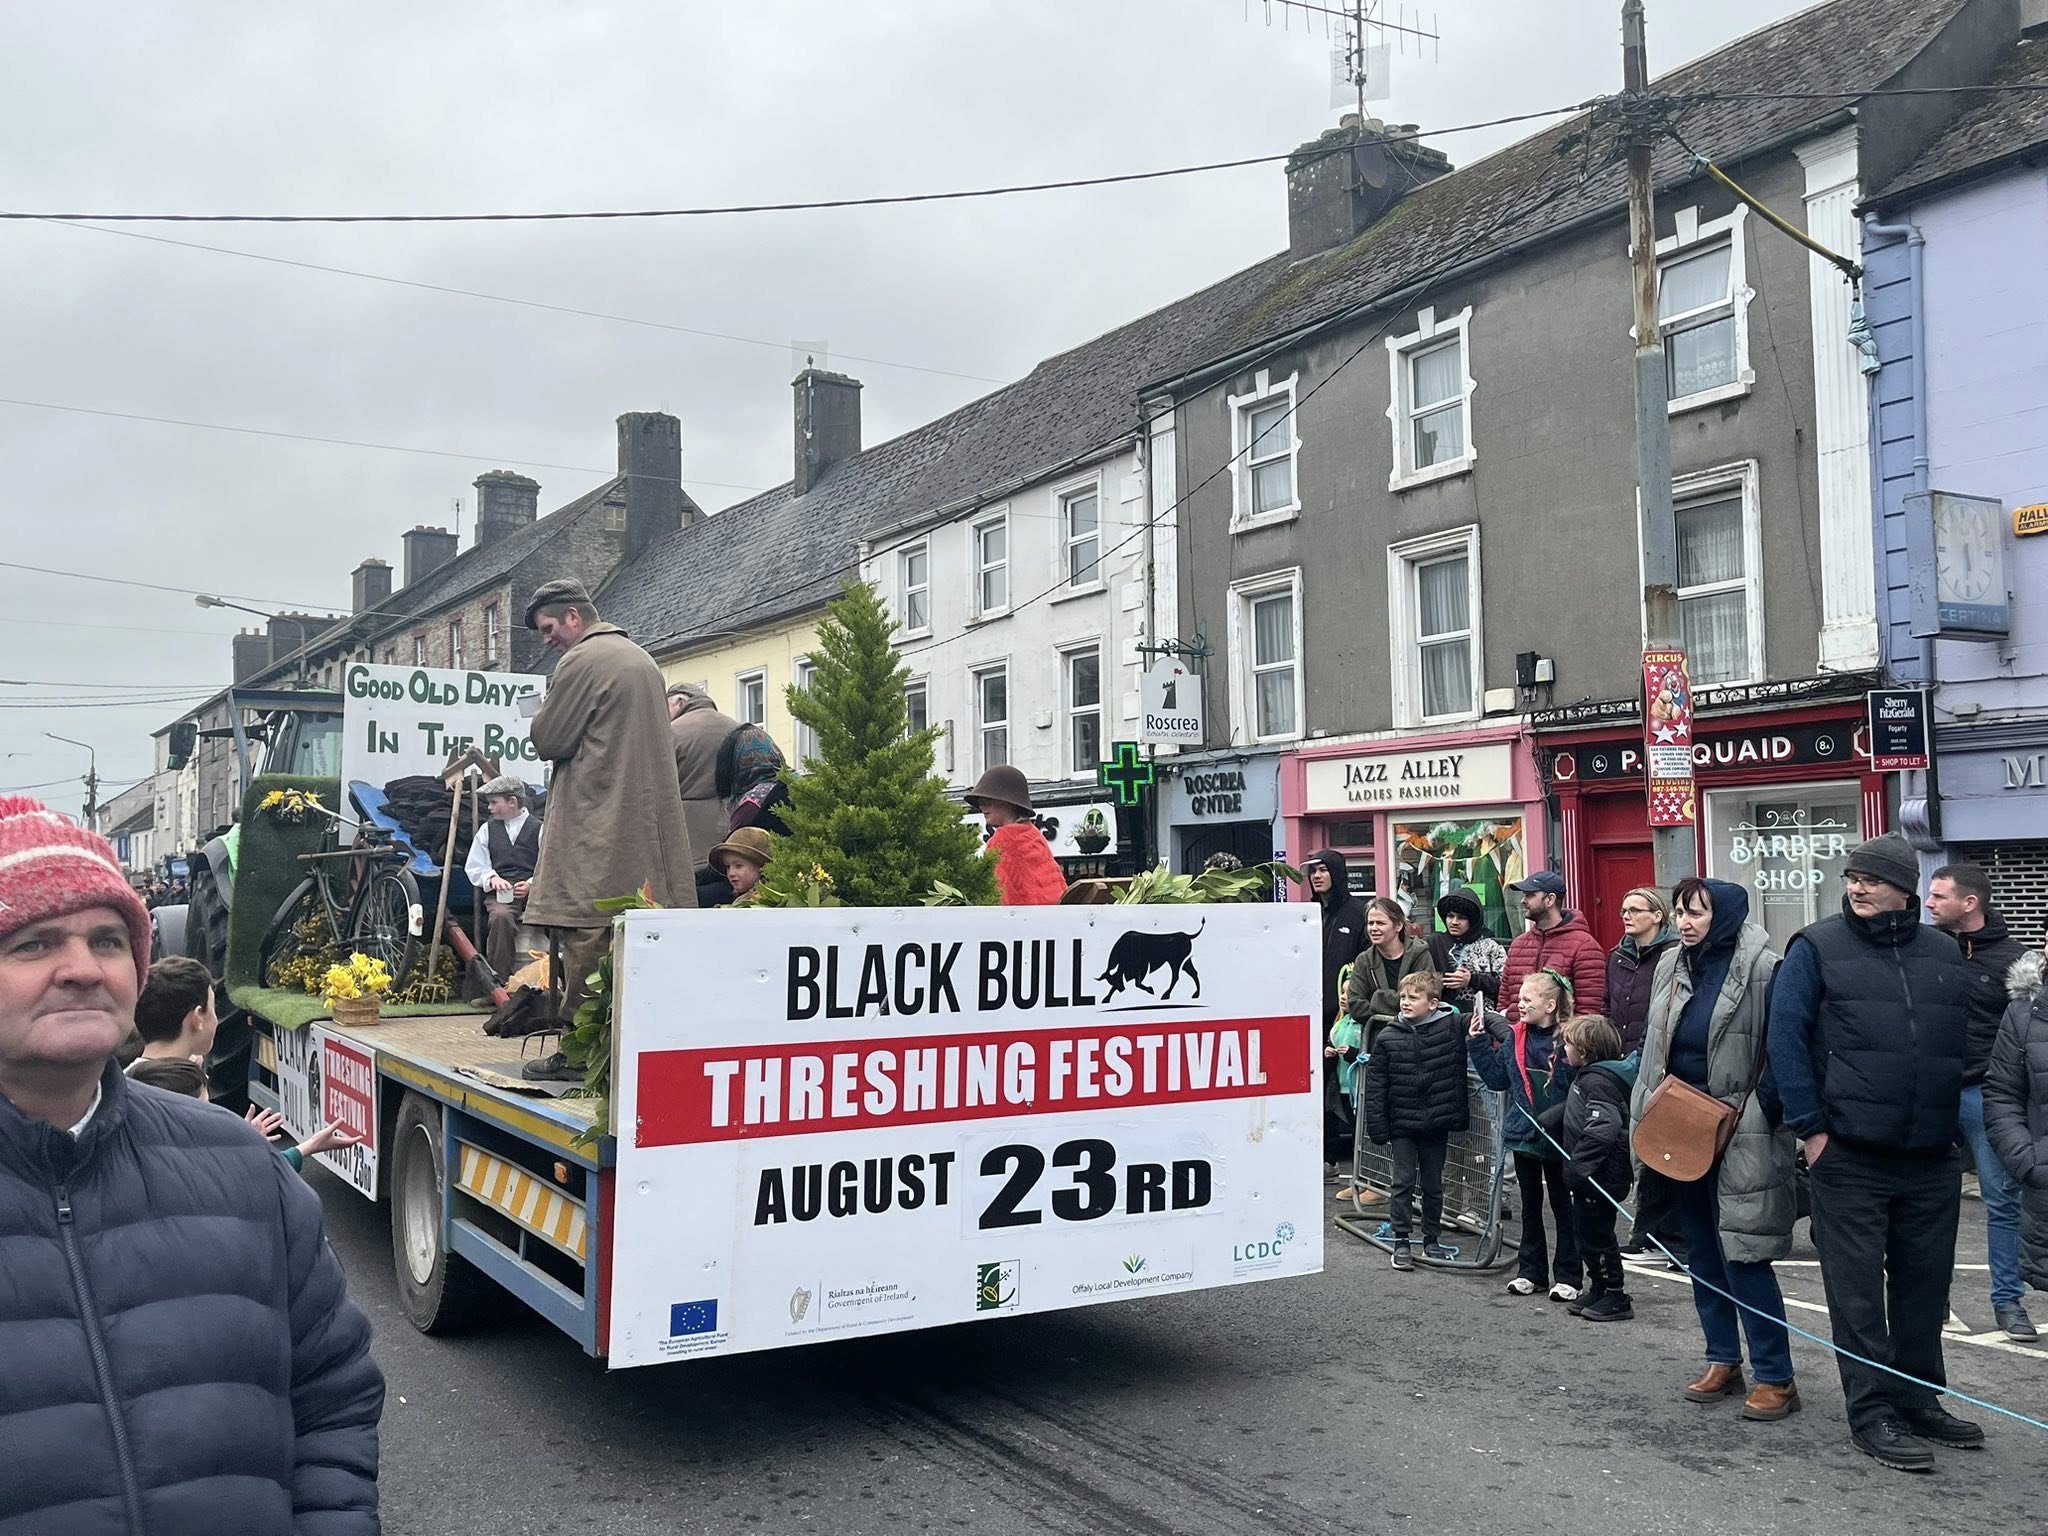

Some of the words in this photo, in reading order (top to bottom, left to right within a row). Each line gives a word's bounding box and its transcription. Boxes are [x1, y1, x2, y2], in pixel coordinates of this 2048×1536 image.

[1940, 608, 2002, 623] CERTINA
[1645, 654, 1683, 663] CIRCUS
[348, 665, 404, 701] GOOD
[409, 670, 460, 706] OLD
[1880, 707, 1915, 718] FitzGerald
[1885, 697, 1908, 709] Sherry
[1146, 714, 1199, 731] Roscrea
[368, 720, 399, 753] IN
[418, 722, 474, 757] THE
[1343, 764, 1388, 788] JAZZ
[1400, 755, 1463, 779] ALLEY
[1621, 750, 1643, 771] P.
[1882, 758, 1899, 766] SHOP
[1909, 757, 1921, 765] LET
[1184, 771, 1247, 795] ROSCREA
[1348, 788, 1392, 801] LADIES
[1399, 784, 1460, 798] FASHION
[1730, 834, 1848, 863] BARBER
[1754, 869, 1825, 890] SHOP
[787, 942, 963, 1021] BLACK
[978, 938, 1096, 1011] BULL
[276, 1024, 308, 1077] BLACK
[325, 1047, 371, 1098] THRESHING
[704, 1041, 1036, 1128] THRESHING
[1049, 1029, 1268, 1102] FESTIVAL
[283, 1077, 305, 1137] BULL
[329, 1086, 368, 1137] FESTIVAL
[753, 1151, 956, 1226] AUGUST
[978, 1138, 1212, 1230] 23RD
[1234, 1240, 1282, 1261] LCDC
[828, 1288, 854, 1299] Rialtas
[855, 1288, 864, 1296] na
[1072, 1284, 1093, 1294] Offaly
[1094, 1281, 1112, 1291] Local
[1113, 1275, 1159, 1289] Development
[1161, 1271, 1193, 1282] Company
[828, 1297, 873, 1309] Government
[874, 1294, 883, 1303] of
[884, 1290, 909, 1302] Ireland
